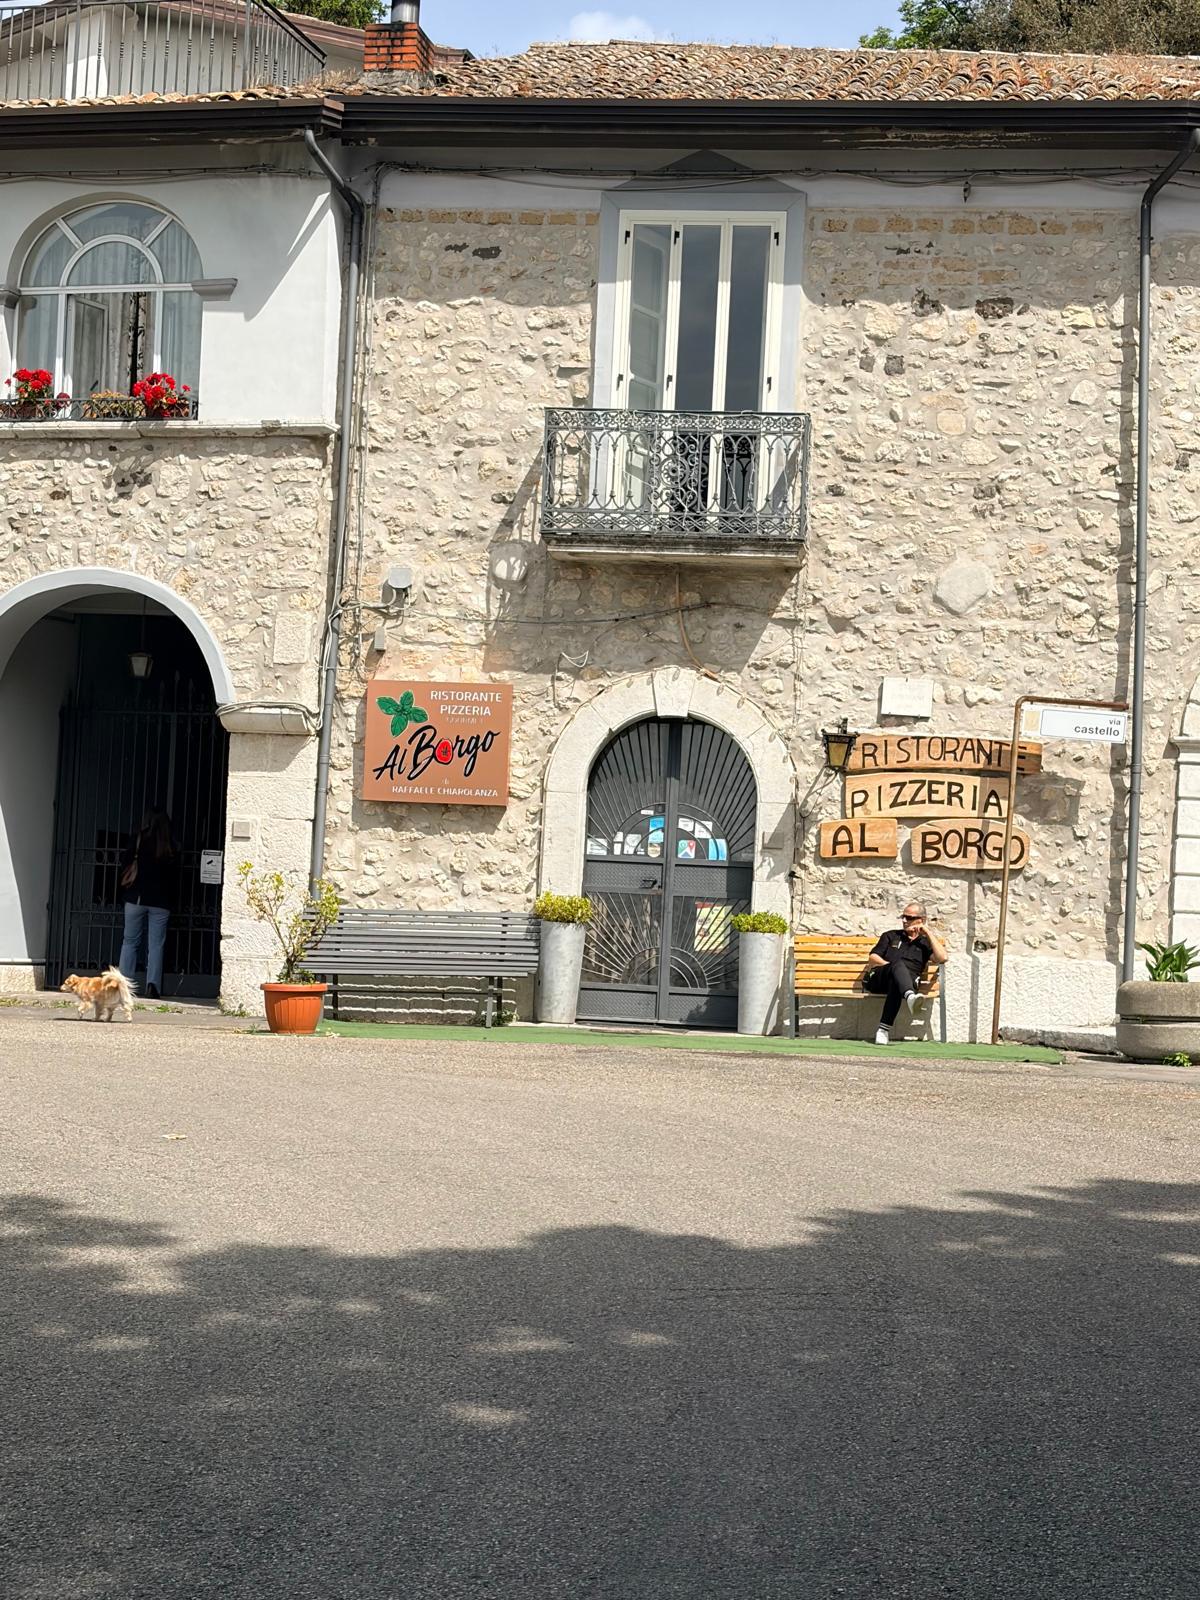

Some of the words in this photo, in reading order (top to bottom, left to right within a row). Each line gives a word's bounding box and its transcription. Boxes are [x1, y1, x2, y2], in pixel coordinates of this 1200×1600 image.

[430, 690, 503, 702] RISTORANTE
[440, 704, 492, 716] PIZZERIA
[1074, 725, 1120, 736] castello
[373, 744, 408, 781] Al
[407, 724, 501, 781] Borgo
[851, 779, 1003, 818] PIZZERIA
[831, 822, 879, 856] AL
[921, 827, 1025, 866] BORGO
